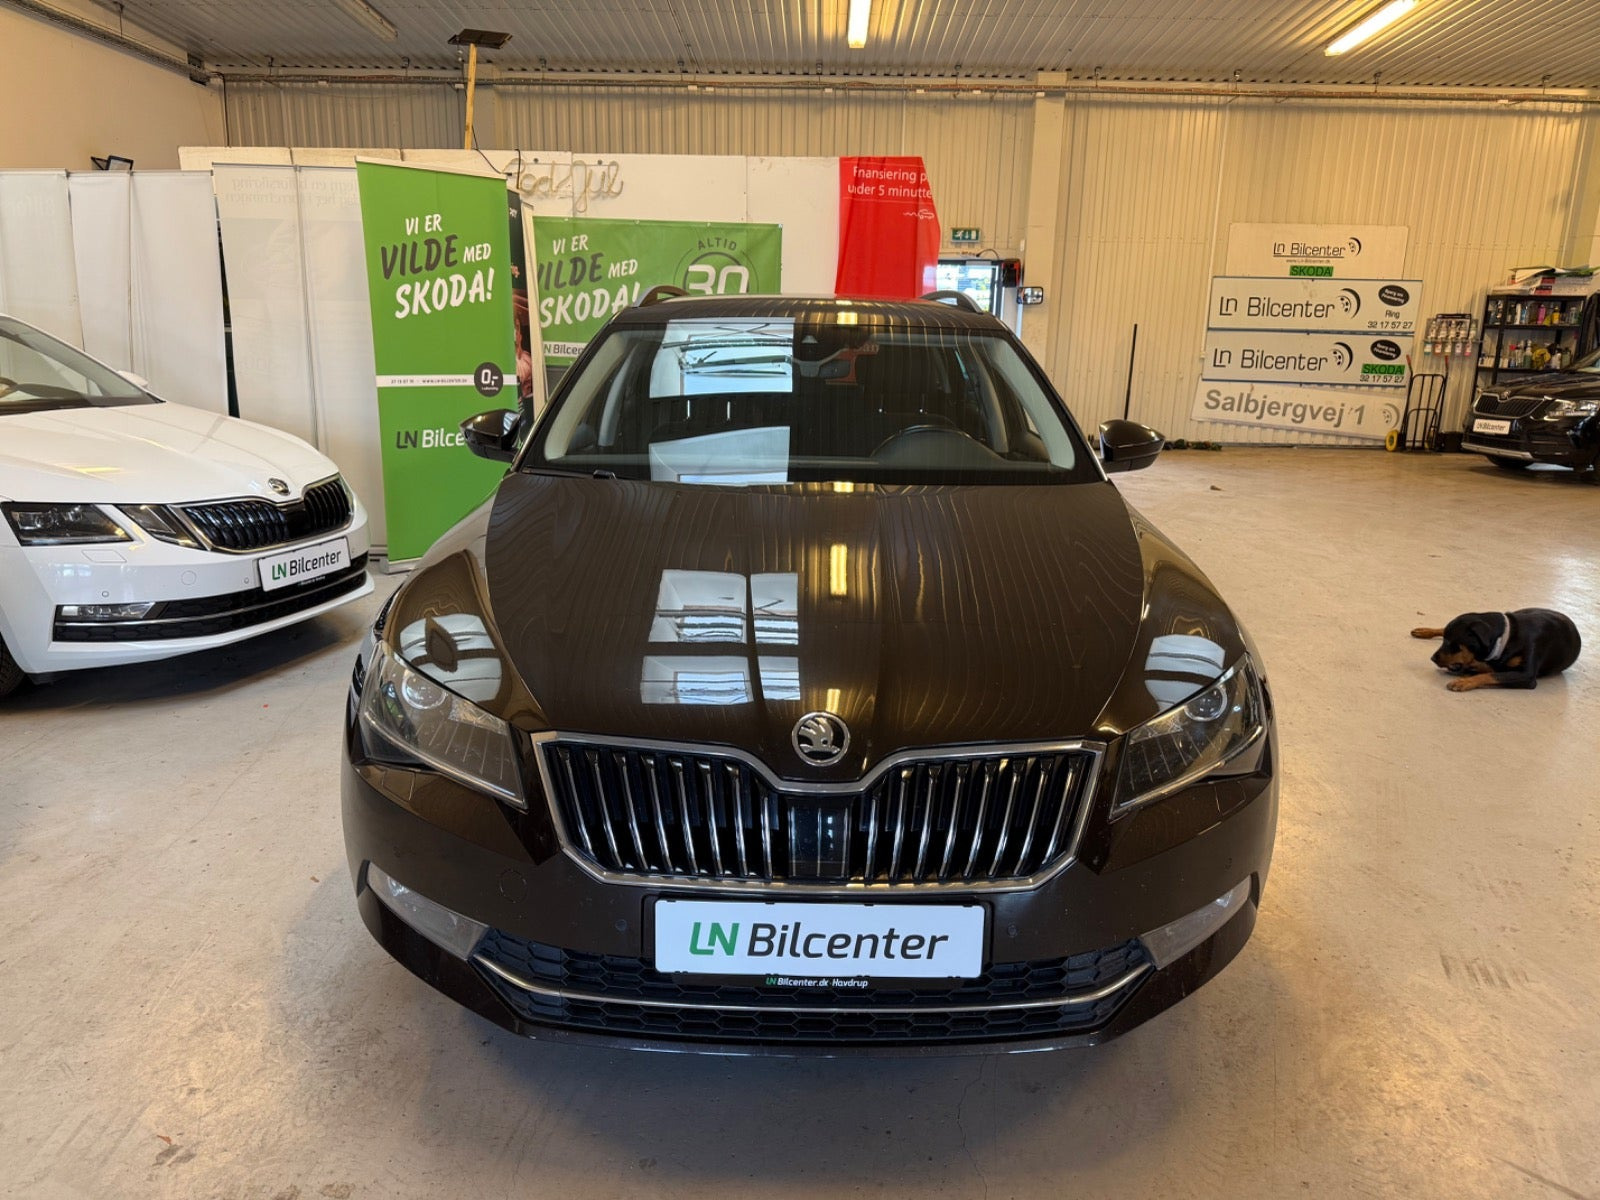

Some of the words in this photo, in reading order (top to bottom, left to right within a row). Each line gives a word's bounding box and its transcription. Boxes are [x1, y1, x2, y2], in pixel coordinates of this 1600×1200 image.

[853, 166, 917, 184] Fnansiering
[878, 184, 885, 196] 5
[405, 216, 419, 236] VI
[424, 213, 443, 233] ER
[552, 238, 566, 255] VI
[571, 234, 589, 252] ER
[698, 237, 737, 251] ALTID
[1290, 242, 1346, 256] Bilcenter
[380, 234, 459, 281] VILDE
[463, 242, 492, 264] MED
[608, 258, 639, 279] MED
[1291, 265, 1333, 276] SKODA
[688, 264, 750, 295] 30
[395, 266, 495, 320] SKODA!
[1247, 296, 1335, 318] Bilcenter
[1385, 309, 1400, 320] Ring
[1380, 321, 1389, 329] 17
[1391, 321, 1401, 329] 57
[1402, 321, 1413, 329] 27
[544, 344, 551, 354] N
[1240, 349, 1328, 371] Bilcenter
[1363, 363, 1405, 375] SKODA
[1372, 375, 1381, 383] 17
[1382, 375, 1393, 383] 57
[1394, 375, 1405, 384] 27
[1204, 388, 1345, 428] Salbjergvej
[1353, 404, 1366, 426] 1
[396, 430, 418, 449] LN
[272, 562, 287, 581] LN
[289, 550, 342, 577] Bilcenter
[689, 921, 740, 957] LN
[746, 921, 949, 960] Bilcenter
[832, 978, 868, 989] Havdrup
